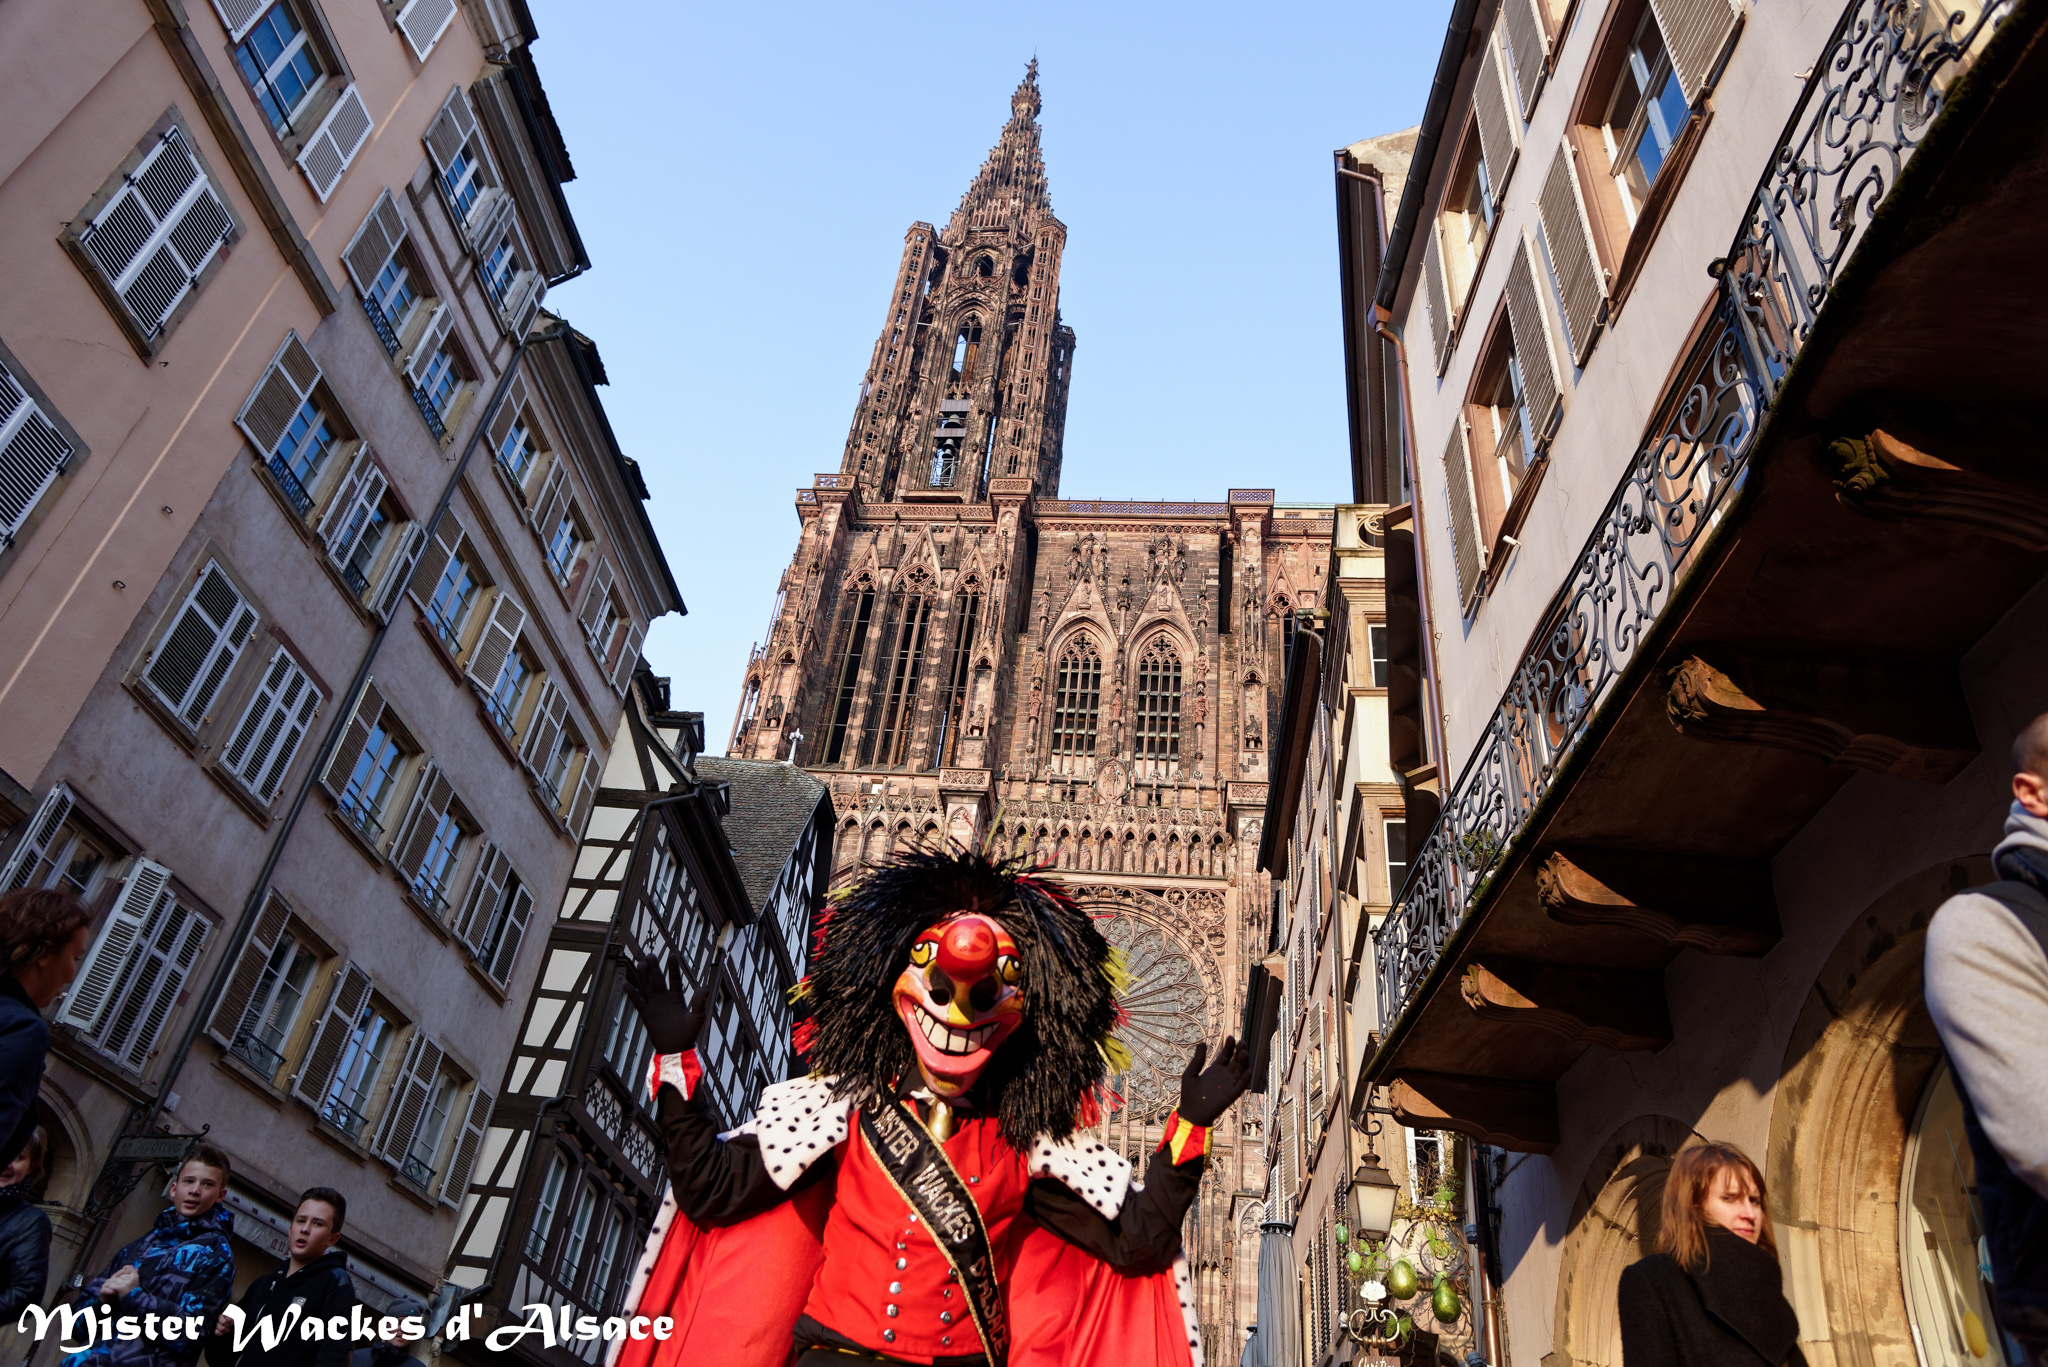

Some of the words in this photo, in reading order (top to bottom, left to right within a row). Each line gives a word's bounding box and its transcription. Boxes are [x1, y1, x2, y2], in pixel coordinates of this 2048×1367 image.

[871, 1103, 920, 1165] MISTER
[911, 1162, 976, 1244] WACKES
[969, 1256, 1008, 1357] D'ALSACE
